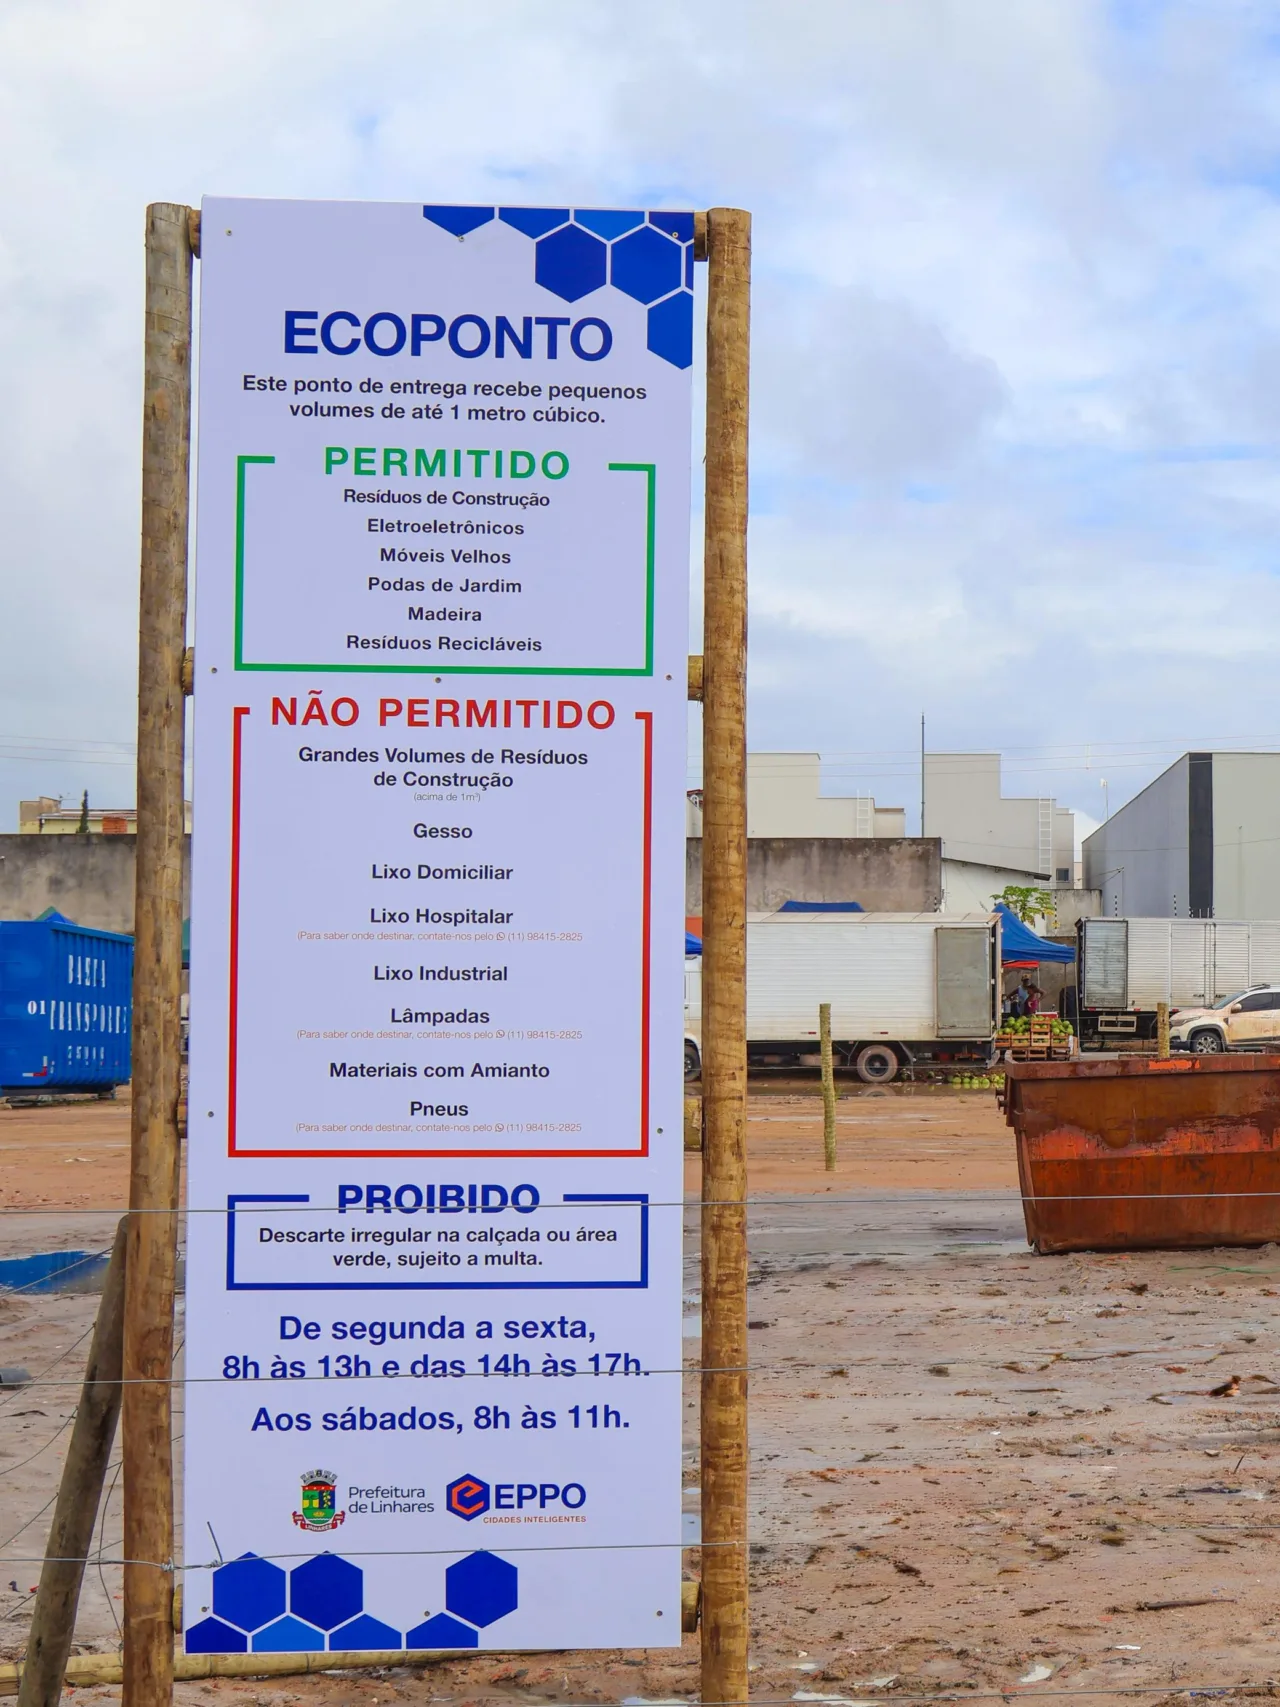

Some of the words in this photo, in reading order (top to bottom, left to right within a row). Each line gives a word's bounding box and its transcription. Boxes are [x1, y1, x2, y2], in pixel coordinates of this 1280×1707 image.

[285, 311, 612, 361] ECOPONTO
[244, 375, 287, 391] Este
[294, 378, 352, 396] ponto
[359, 378, 383, 393] de
[390, 380, 466, 399] entrega
[474, 381, 542, 397] recebe
[549, 386, 646, 401] pequenos
[290, 401, 374, 418] volumes
[381, 403, 405, 418] de
[412, 404, 443, 419] até
[451, 405, 458, 419] 1
[468, 406, 525, 421] metro
[533, 405, 605, 423] cúbico.
[325, 447, 569, 480] PERMITIDO
[344, 489, 421, 503] Resíduos
[427, 491, 447, 504] de
[452, 491, 550, 509] Construção
[368, 519, 524, 534] Eletroeletrônicos
[381, 548, 444, 562] Móveis
[451, 549, 511, 563] Velhos
[369, 577, 425, 591] Podas
[432, 578, 453, 592] de
[460, 579, 521, 592] Jardim
[409, 607, 481, 621] Madeira
[347, 635, 431, 650] Resíduos
[439, 636, 541, 651] Recicláveis
[272, 690, 359, 726] NÃO
[379, 698, 615, 729] PERMITIDO
[299, 747, 379, 762] Grandes
[385, 748, 465, 763] Volumes
[472, 749, 494, 763] de
[501, 749, 588, 764] Resíduos
[374, 771, 396, 786] de
[403, 771, 513, 791] Construção
[413, 792, 443, 802] (acima
[446, 792, 457, 802] de
[414, 823, 472, 838] Gesso
[372, 864, 411, 879] Lixo
[418, 865, 513, 879] Domiciliar
[371, 908, 409, 923] Lixo
[416, 909, 513, 927] Hospitalar
[297, 930, 321, 941] (Para
[323, 931, 349, 940] saber
[351, 931, 374, 941] onde
[418, 932, 472, 941] contate-nos
[475, 932, 494, 942] pelo
[527, 932, 582, 942] 98415-2825
[375, 966, 413, 980] Lixo
[420, 966, 507, 981] Industrial
[391, 1008, 489, 1026] Lâmpadas
[296, 1029, 320, 1040] (Para
[323, 1029, 348, 1039] saber
[351, 1029, 374, 1039] onde
[417, 1029, 471, 1040] contate-nos
[474, 1030, 493, 1042] pelo
[527, 1030, 582, 1040] 98415-2825
[330, 1063, 417, 1077] Materiais
[424, 1066, 464, 1077] com
[471, 1063, 549, 1077] Amianto
[411, 1101, 468, 1116] Pneus
[295, 1122, 319, 1134] (Para
[322, 1123, 347, 1133] saber
[350, 1123, 373, 1132] onde
[416, 1123, 470, 1132] contate-nos
[473, 1123, 492, 1133] pelo
[526, 1122, 581, 1133] 98415-2825
[338, 1183, 541, 1214] PROIBIDO
[260, 1228, 345, 1242] Descarte
[352, 1228, 431, 1246] irregular
[438, 1231, 459, 1242] na
[467, 1227, 540, 1246] calçada
[547, 1231, 569, 1241] ou
[576, 1227, 616, 1241] área
[333, 1251, 390, 1268] verde,
[398, 1251, 460, 1269] sujeito
[467, 1255, 477, 1265] a
[485, 1251, 542, 1265] multa.
[280, 1316, 321, 1340] De
[332, 1315, 464, 1345] segunda
[476, 1321, 492, 1339] a
[504, 1316, 595, 1343] sexta,
[222, 1355, 259, 1379] 8h
[270, 1355, 305, 1378] às
[318, 1355, 371, 1378] 13h
[382, 1360, 399, 1378] e
[410, 1354, 465, 1377] das
[478, 1354, 530, 1377] 14h
[541, 1353, 576, 1376] às
[587, 1353, 650, 1376] 17h.
[251, 1407, 311, 1431] Aos
[322, 1406, 462, 1434] sábados,
[474, 1406, 510, 1429] 8h
[521, 1405, 556, 1429] às
[568, 1405, 629, 1428] 11h.
[349, 1486, 425, 1498] Prefeitura
[495, 1483, 586, 1509] EPPO
[349, 1501, 367, 1513] de
[371, 1501, 434, 1513] Linhares
